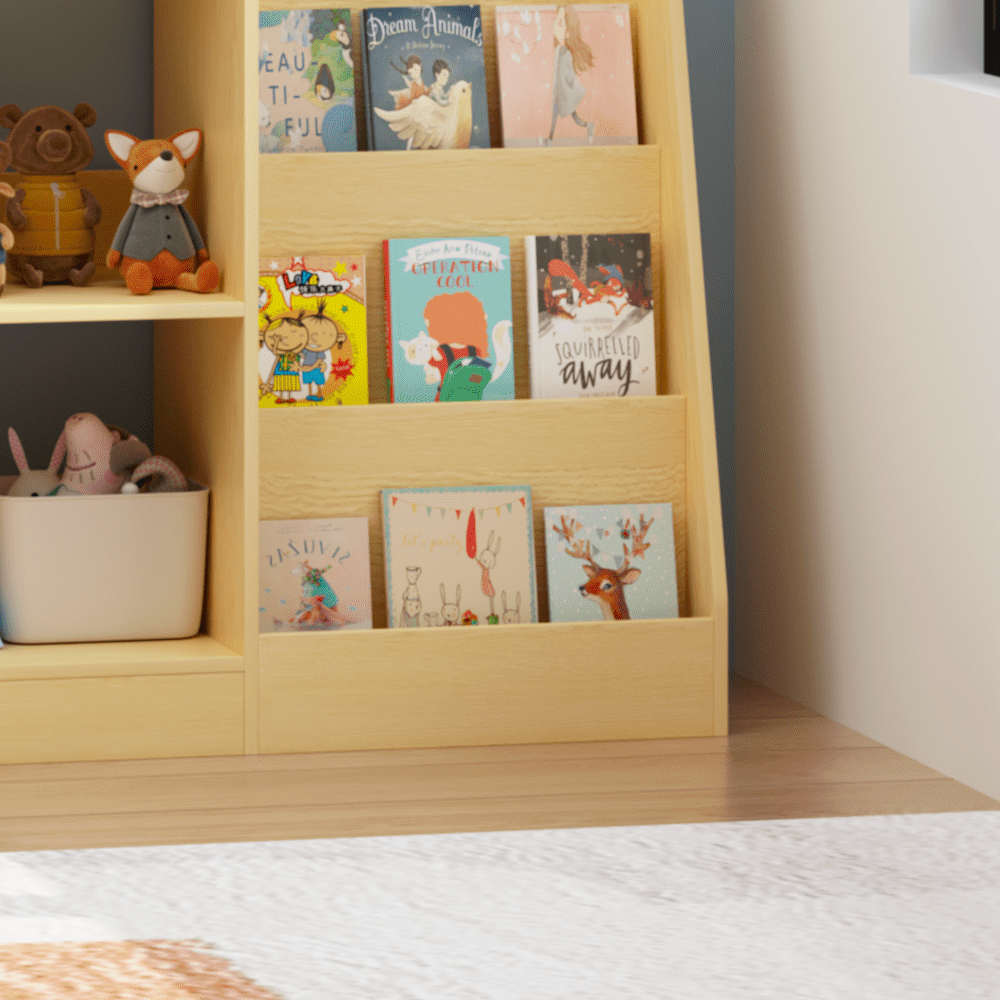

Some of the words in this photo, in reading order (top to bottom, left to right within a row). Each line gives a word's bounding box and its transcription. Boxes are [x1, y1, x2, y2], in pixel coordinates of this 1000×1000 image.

[367, 12, 419, 50] Dream
[421, 5, 483, 47] Animals
[259, 51, 319, 75] EAU-
[411, 259, 499, 275] OPERATION
[436, 273, 474, 289] COOL
[555, 335, 640, 365] SQUIRRELLED
[559, 358, 640, 397] away
[429, 533, 463, 555] party
